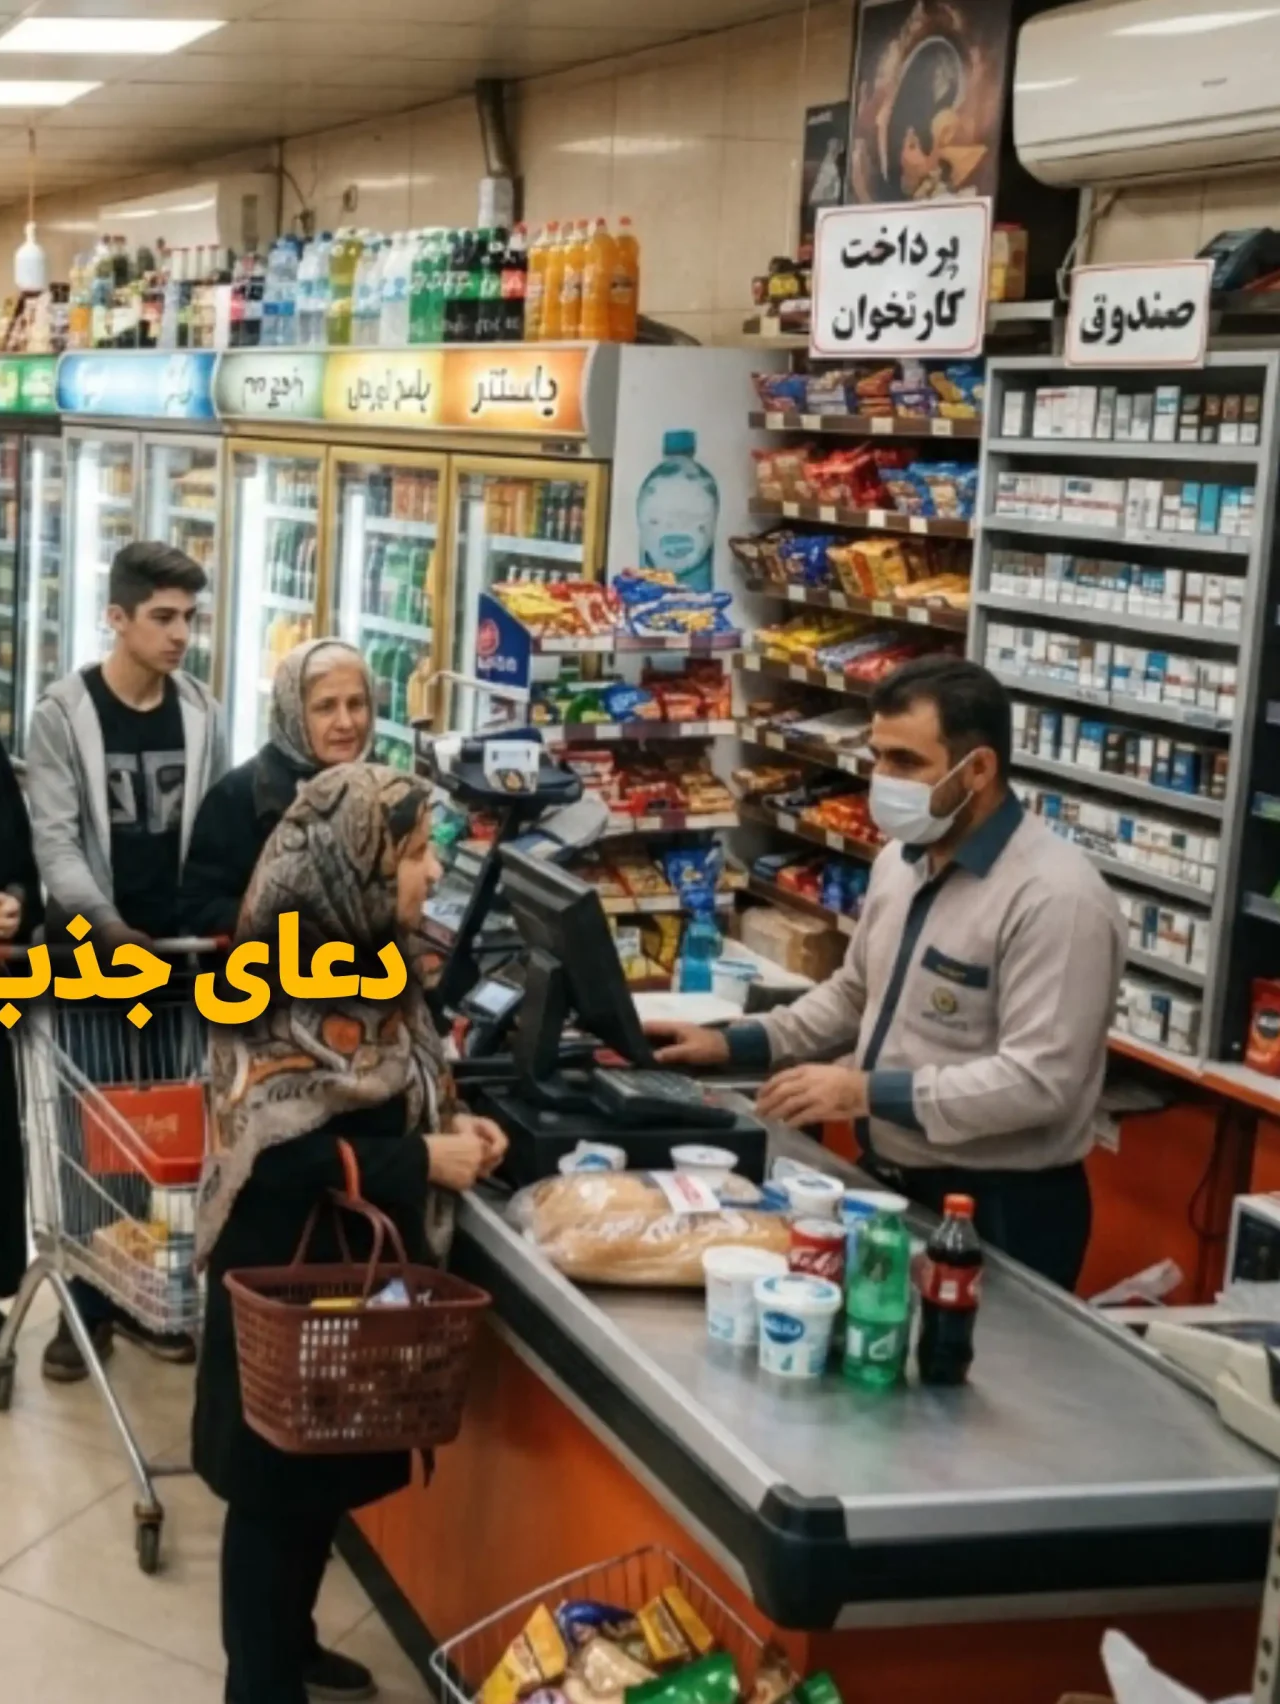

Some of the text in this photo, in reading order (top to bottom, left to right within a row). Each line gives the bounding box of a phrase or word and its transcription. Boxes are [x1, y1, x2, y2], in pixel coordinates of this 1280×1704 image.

[840, 226, 960, 280] پرداخت
[832, 288, 967, 343] کارتخوان
[1080, 291, 1196, 346] صندوق
